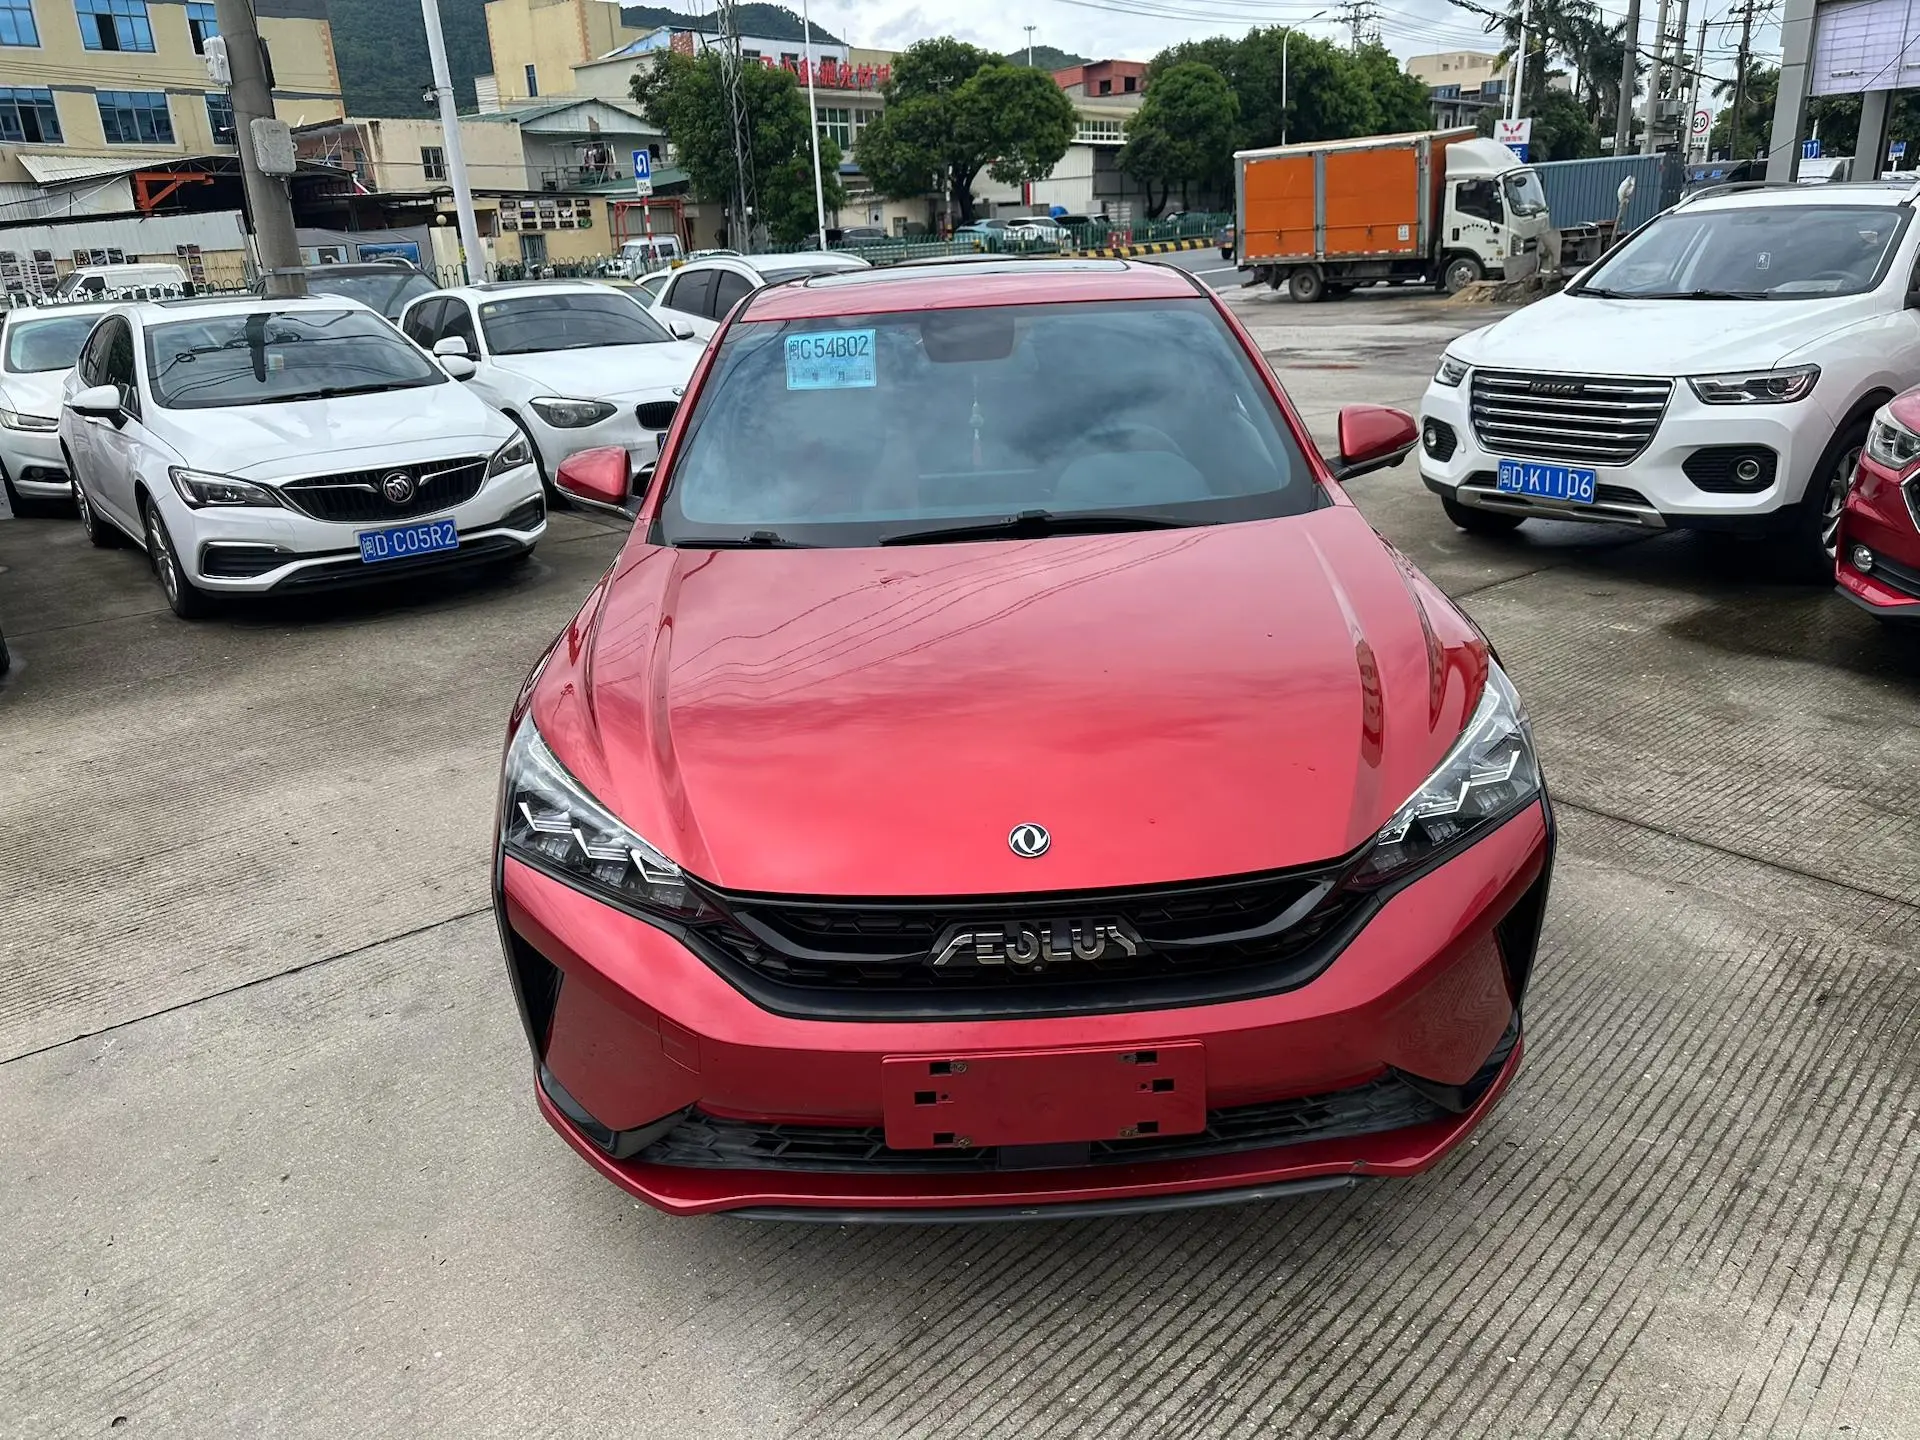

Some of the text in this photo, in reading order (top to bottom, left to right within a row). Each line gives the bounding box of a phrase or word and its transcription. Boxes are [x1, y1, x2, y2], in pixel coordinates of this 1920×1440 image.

[1693, 117, 1706, 128] 60
[1529, 382, 1580, 394] HAVAL
[933, 925, 1137, 967] AEOLUS
